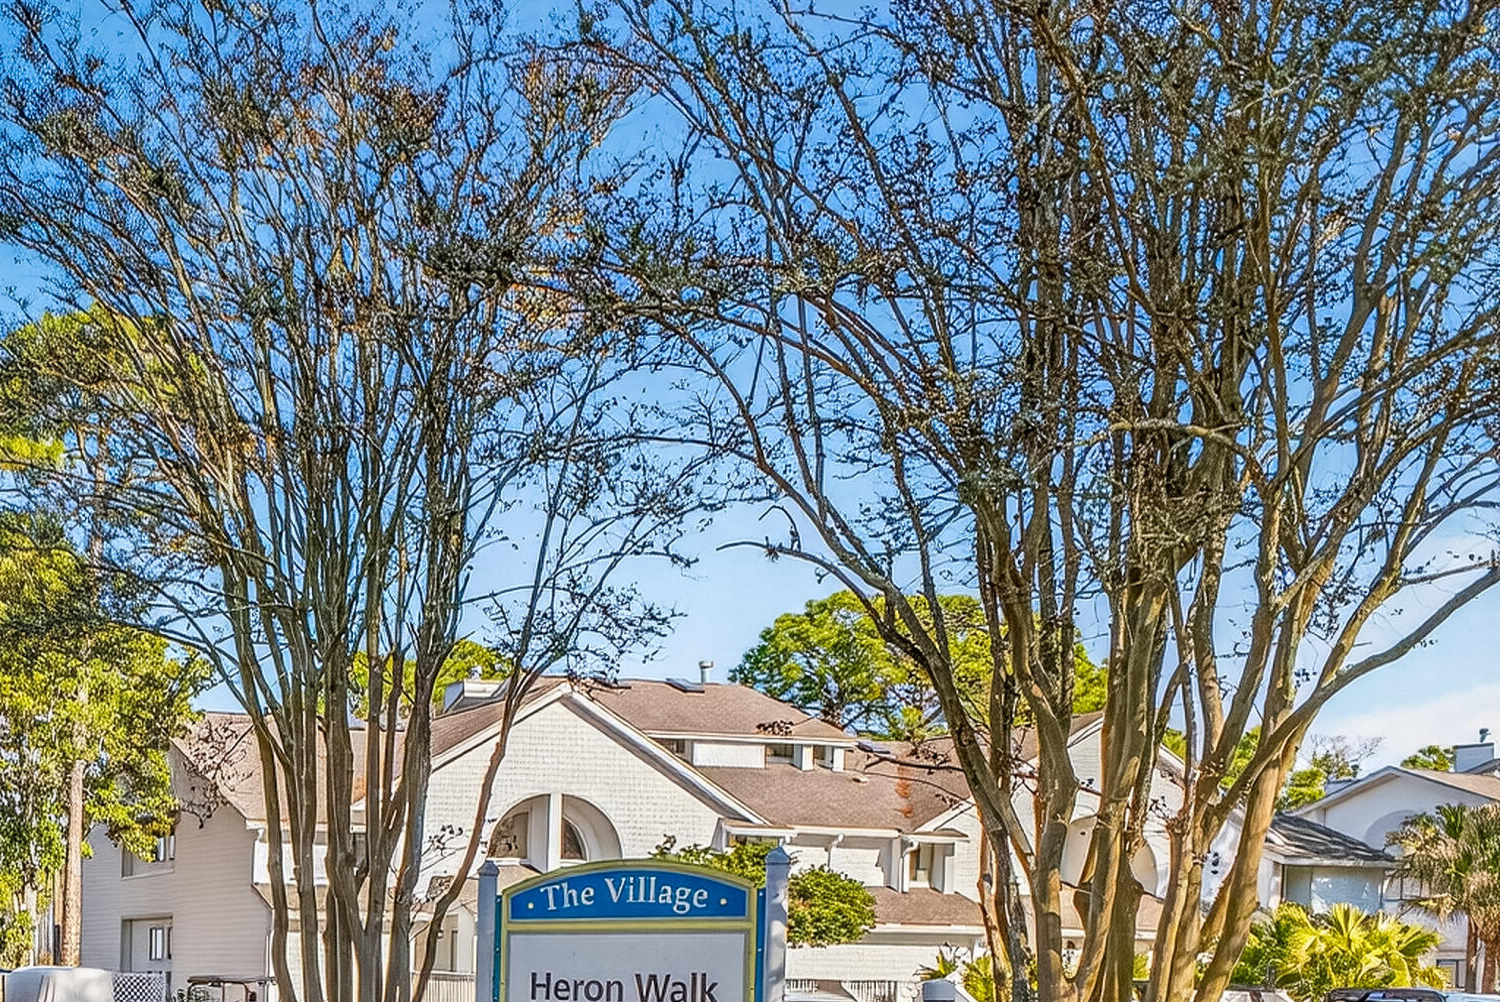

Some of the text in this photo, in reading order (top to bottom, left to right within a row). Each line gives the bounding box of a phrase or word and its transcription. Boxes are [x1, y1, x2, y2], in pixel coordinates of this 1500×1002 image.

[540, 876, 709, 914] The Village
[530, 971, 624, 1002] Heron
